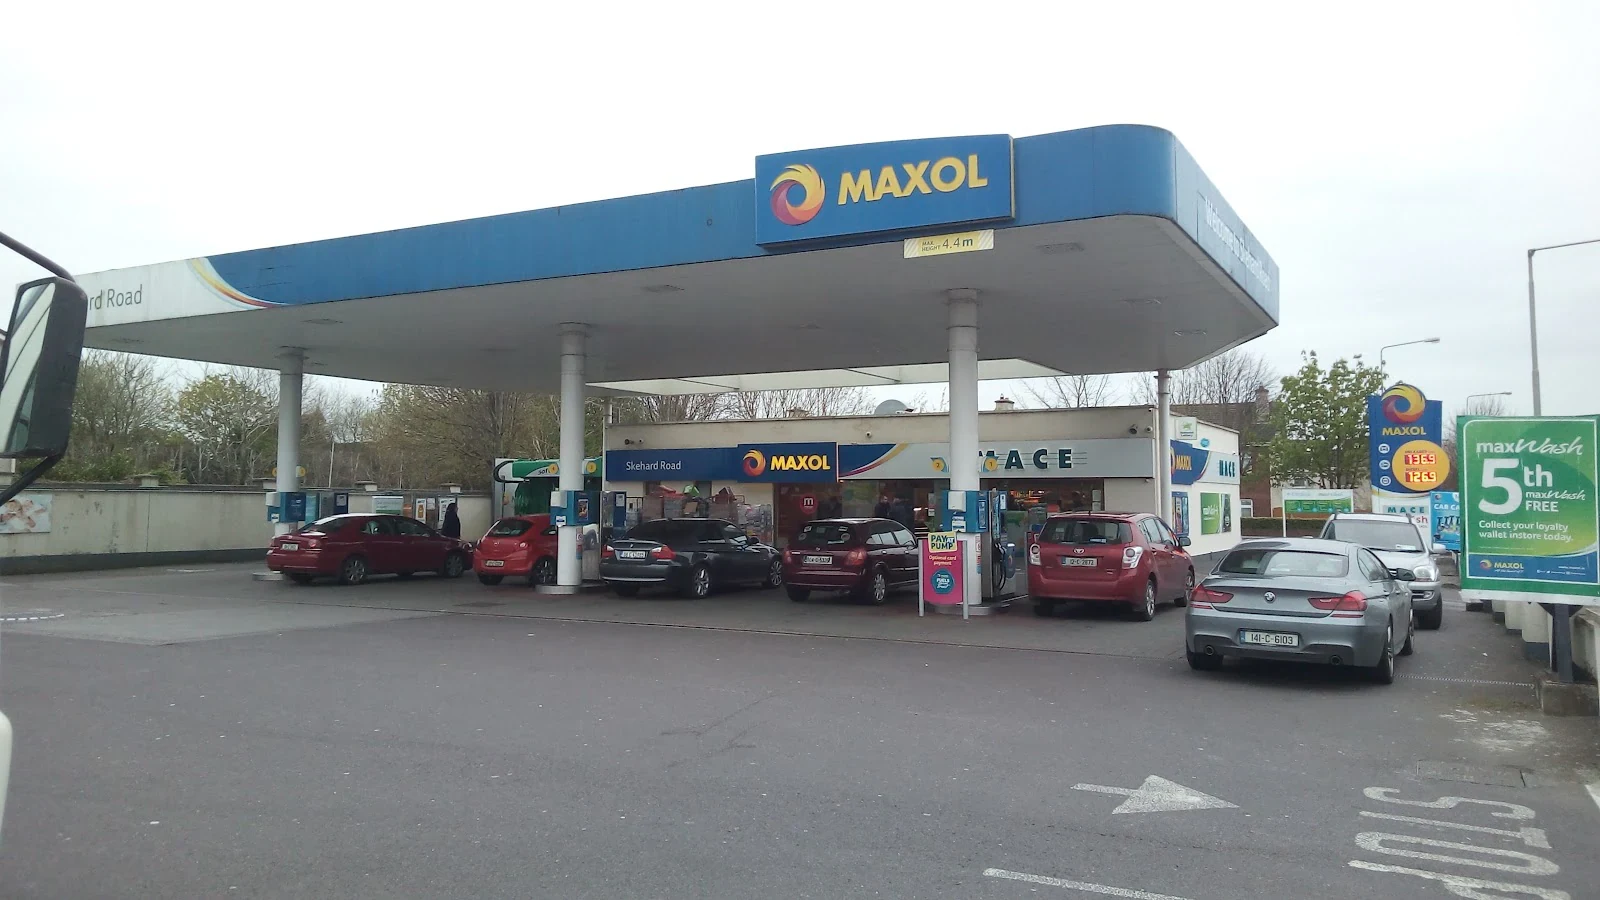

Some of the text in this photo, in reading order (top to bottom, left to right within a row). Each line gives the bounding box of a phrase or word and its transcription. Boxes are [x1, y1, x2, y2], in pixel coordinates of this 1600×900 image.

[837, 154, 988, 206] MAXOL
[89, 284, 143, 310] rd Road
[1382, 426, 1427, 436] MAXOL
[1476, 436, 1584, 456] maxWash
[626, 459, 682, 471] Skehard Road
[770, 455, 831, 471] MAXOL
[1525, 490, 1586, 501] maxWash
[1525, 501, 1559, 512] FREE
[1478, 520, 1568, 532] Collect your loyalty
[930, 534, 947, 543] PAY
[1478, 531, 1574, 542] wallet instore today.
[930, 542, 954, 550] PUMP
[1494, 562, 1524, 570] MAXOL
[1250, 633, 1294, 645] 141-C-6103
